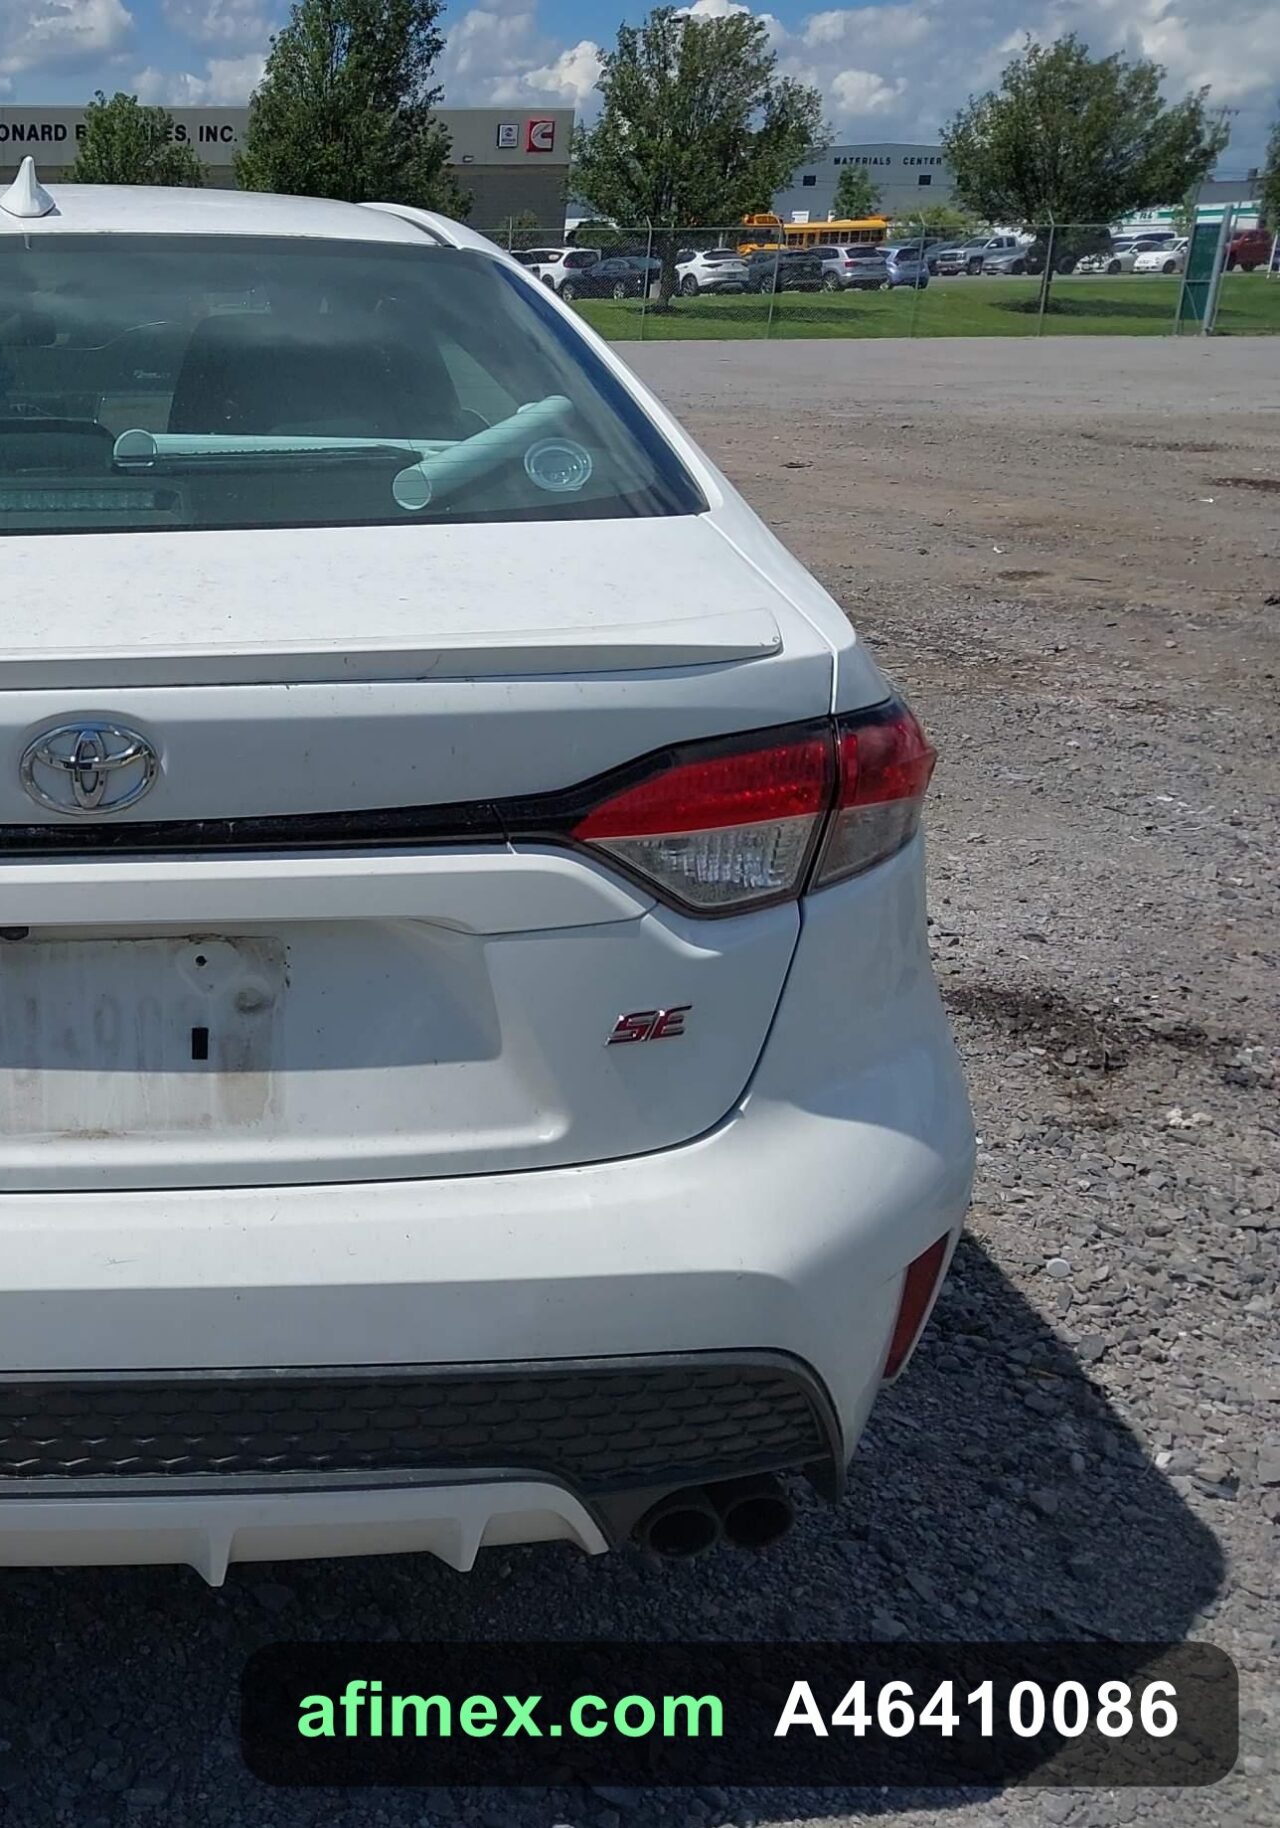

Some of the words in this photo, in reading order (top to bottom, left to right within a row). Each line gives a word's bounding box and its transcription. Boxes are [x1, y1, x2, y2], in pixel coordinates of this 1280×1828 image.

[199, 124, 238, 143] INC.
[833, 156, 891, 166] MATERIALS
[902, 156, 942, 166] CENTER
[604, 1004, 693, 1047] SE
